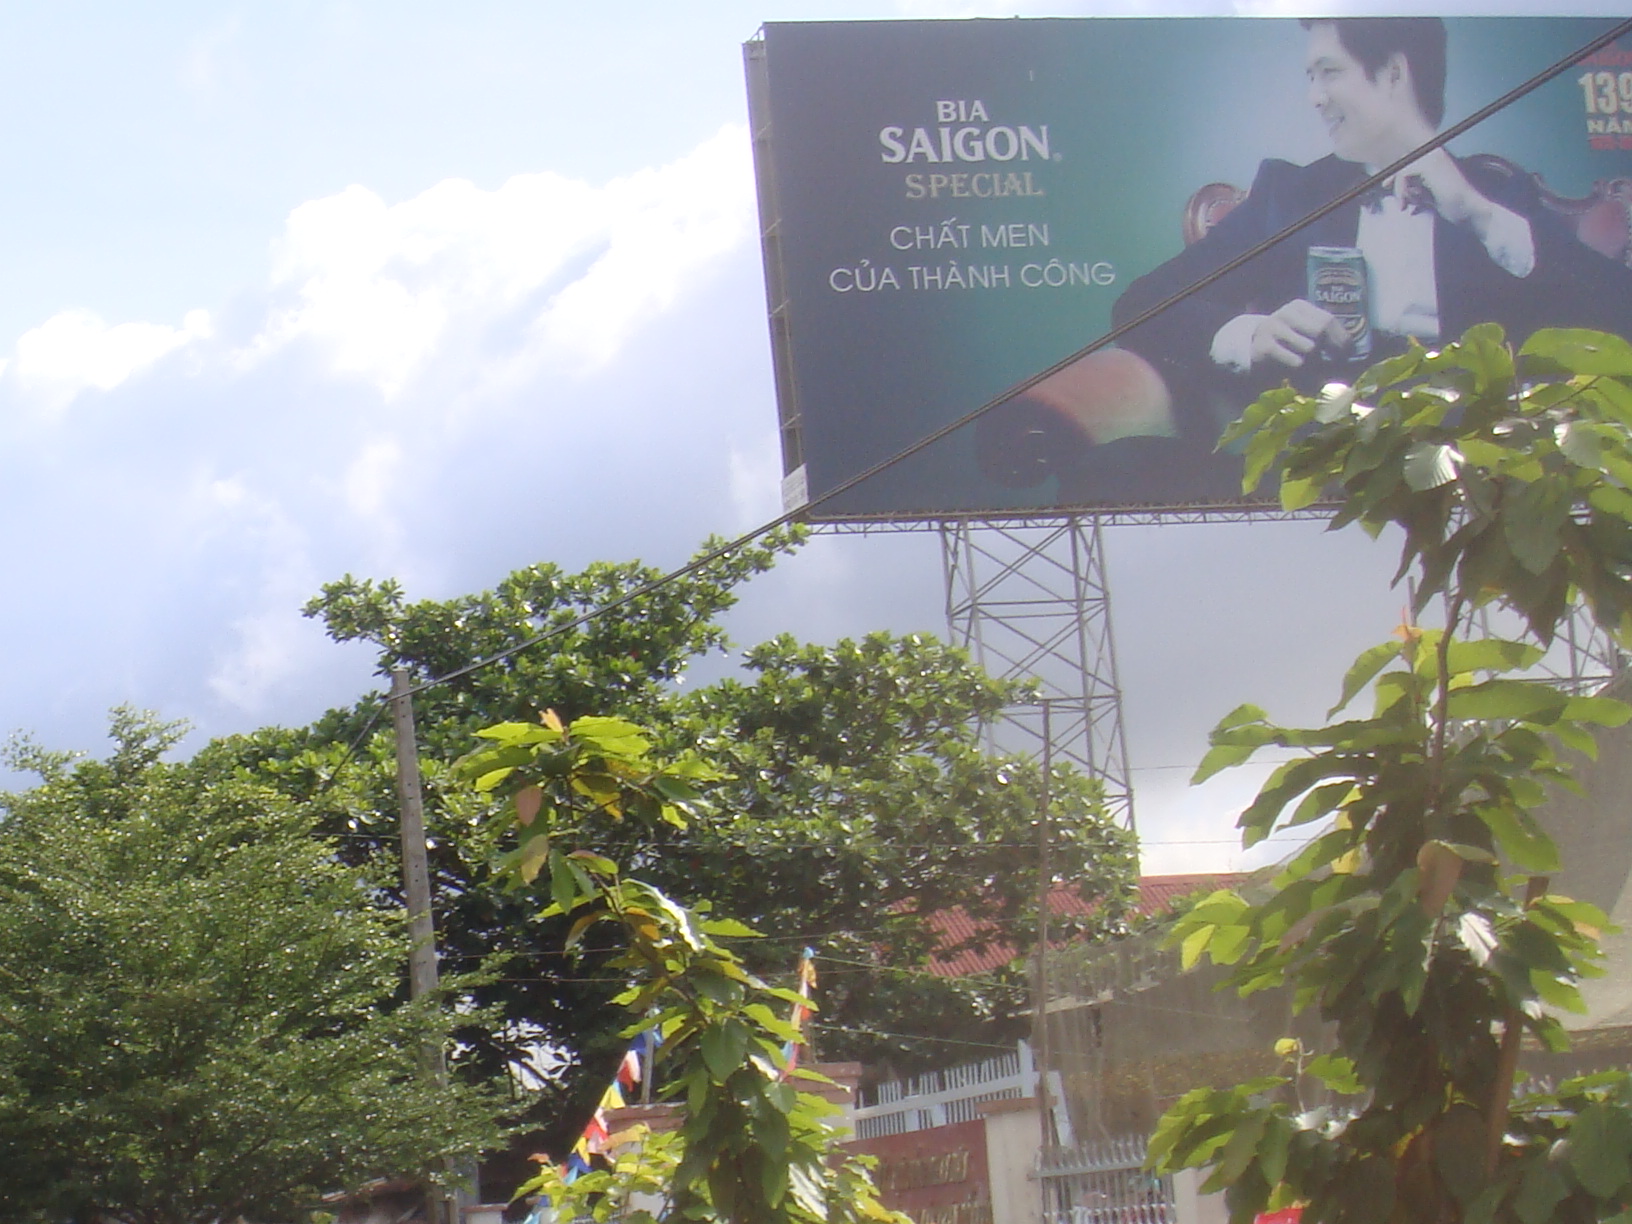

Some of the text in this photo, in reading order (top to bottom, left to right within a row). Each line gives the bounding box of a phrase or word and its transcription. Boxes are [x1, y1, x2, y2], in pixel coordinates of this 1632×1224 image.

[1577, 71, 1632, 114] 139
[936, 99, 990, 123] BIA
[878, 124, 1050, 164] SAIGON
[904, 171, 1046, 199] SPECIAL
[889, 216, 1050, 251] CHẤT MEN
[828, 257, 1117, 293] CỦA THÀNH CÔNG
